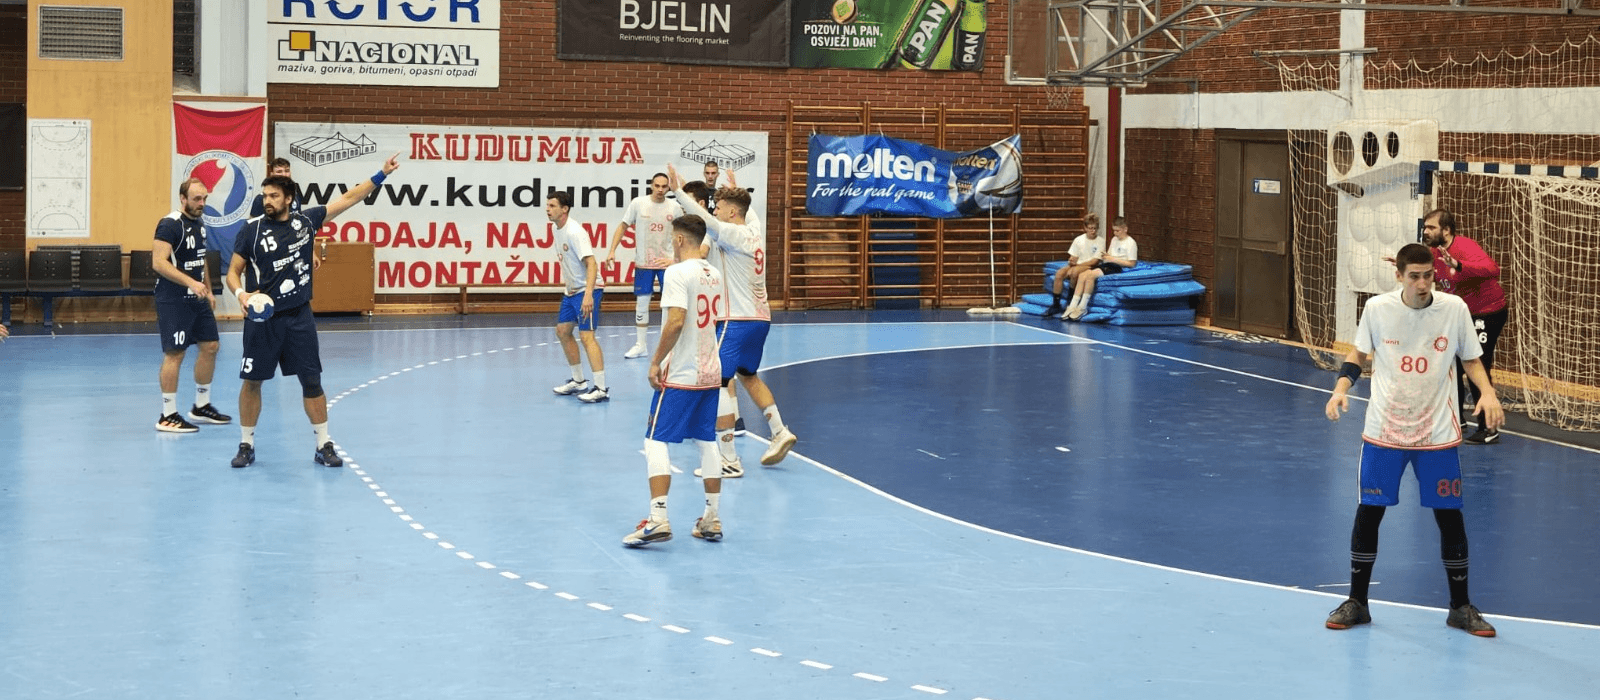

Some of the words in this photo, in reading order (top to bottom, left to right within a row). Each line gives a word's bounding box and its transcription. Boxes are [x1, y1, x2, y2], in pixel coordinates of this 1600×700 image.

[619, 0, 731, 33] BJELIN
[804, 25, 839, 35] POZOVI
[843, 25, 857, 35] NA
[860, 26, 883, 37] PAN,
[909, 2, 947, 53] PAN
[619, 33, 660, 43] Reinventing
[662, 34, 674, 42] the
[676, 35, 703, 45] flooring
[705, 37, 729, 45] market
[811, 34, 849, 47] OSVJEŽI
[853, 36, 876, 47] DAN!
[962, 33, 980, 63] PAN
[315, 40, 479, 65] NACIONAL
[278, 64, 317, 73] maziva,
[320, 65, 356, 75] goriva,
[359, 65, 406, 76] bitumeni,
[409, 67, 443, 77] opasni
[446, 67, 478, 77] otpadi
[409, 132, 644, 163] KUDUMIJA
[816, 148, 935, 182] molten
[812, 183, 836, 198] For
[839, 183, 862, 197] the
[864, 184, 895, 199] real
[894, 190, 935, 203] game
[650, 223, 664, 232] 29
[185, 235, 196, 249] 10
[260, 236, 278, 252] 15
[315, 221, 472, 254] RODAJA,
[486, 222, 607, 248] NAJM
[378, 255, 562, 288] MONTAŽNI
[173, 331, 185, 345] 10
[1478, 332, 1488, 344] 6
[240, 357, 254, 373] 15
[1400, 355, 1428, 373] 80
[1436, 478, 1461, 498] 80
